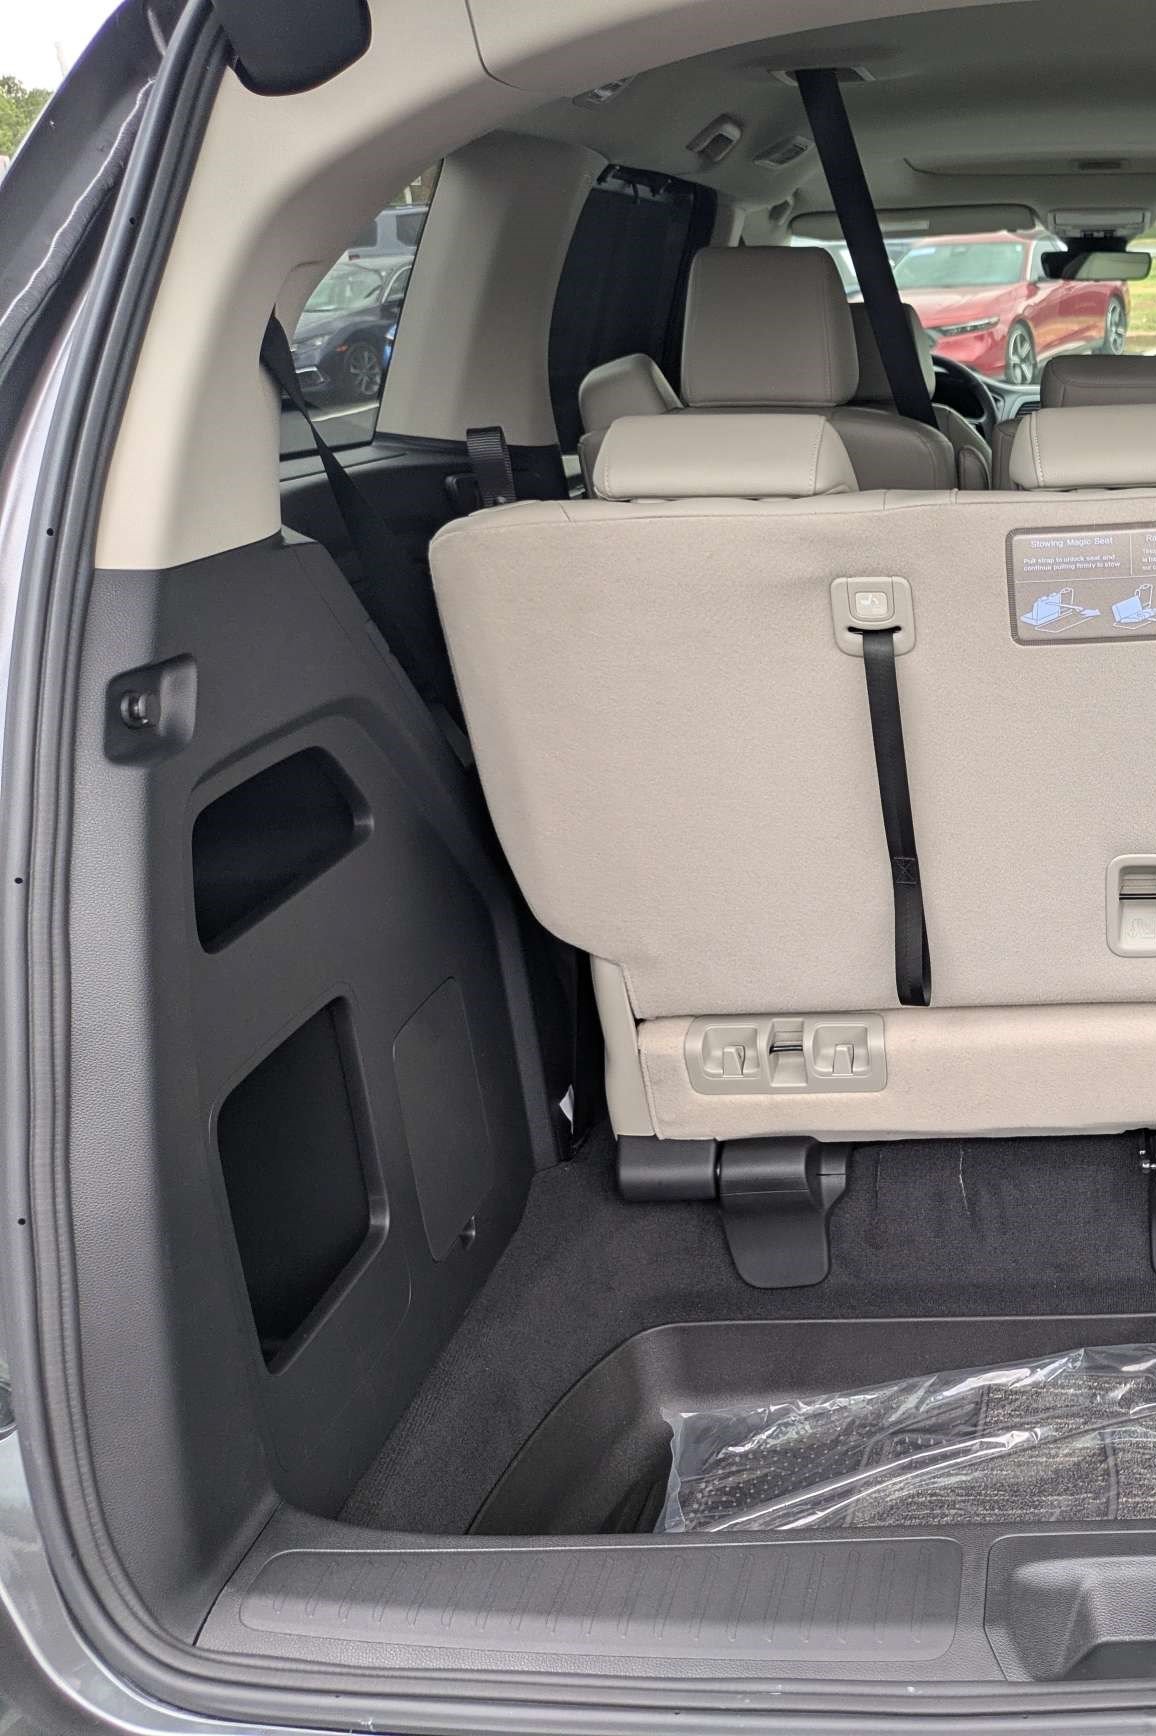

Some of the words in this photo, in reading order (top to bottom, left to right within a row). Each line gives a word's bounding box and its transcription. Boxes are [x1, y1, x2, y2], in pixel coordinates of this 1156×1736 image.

[1031, 538, 1064, 549] Stowing
[1067, 537, 1091, 547] Magic
[1094, 536, 1113, 545] Seat
